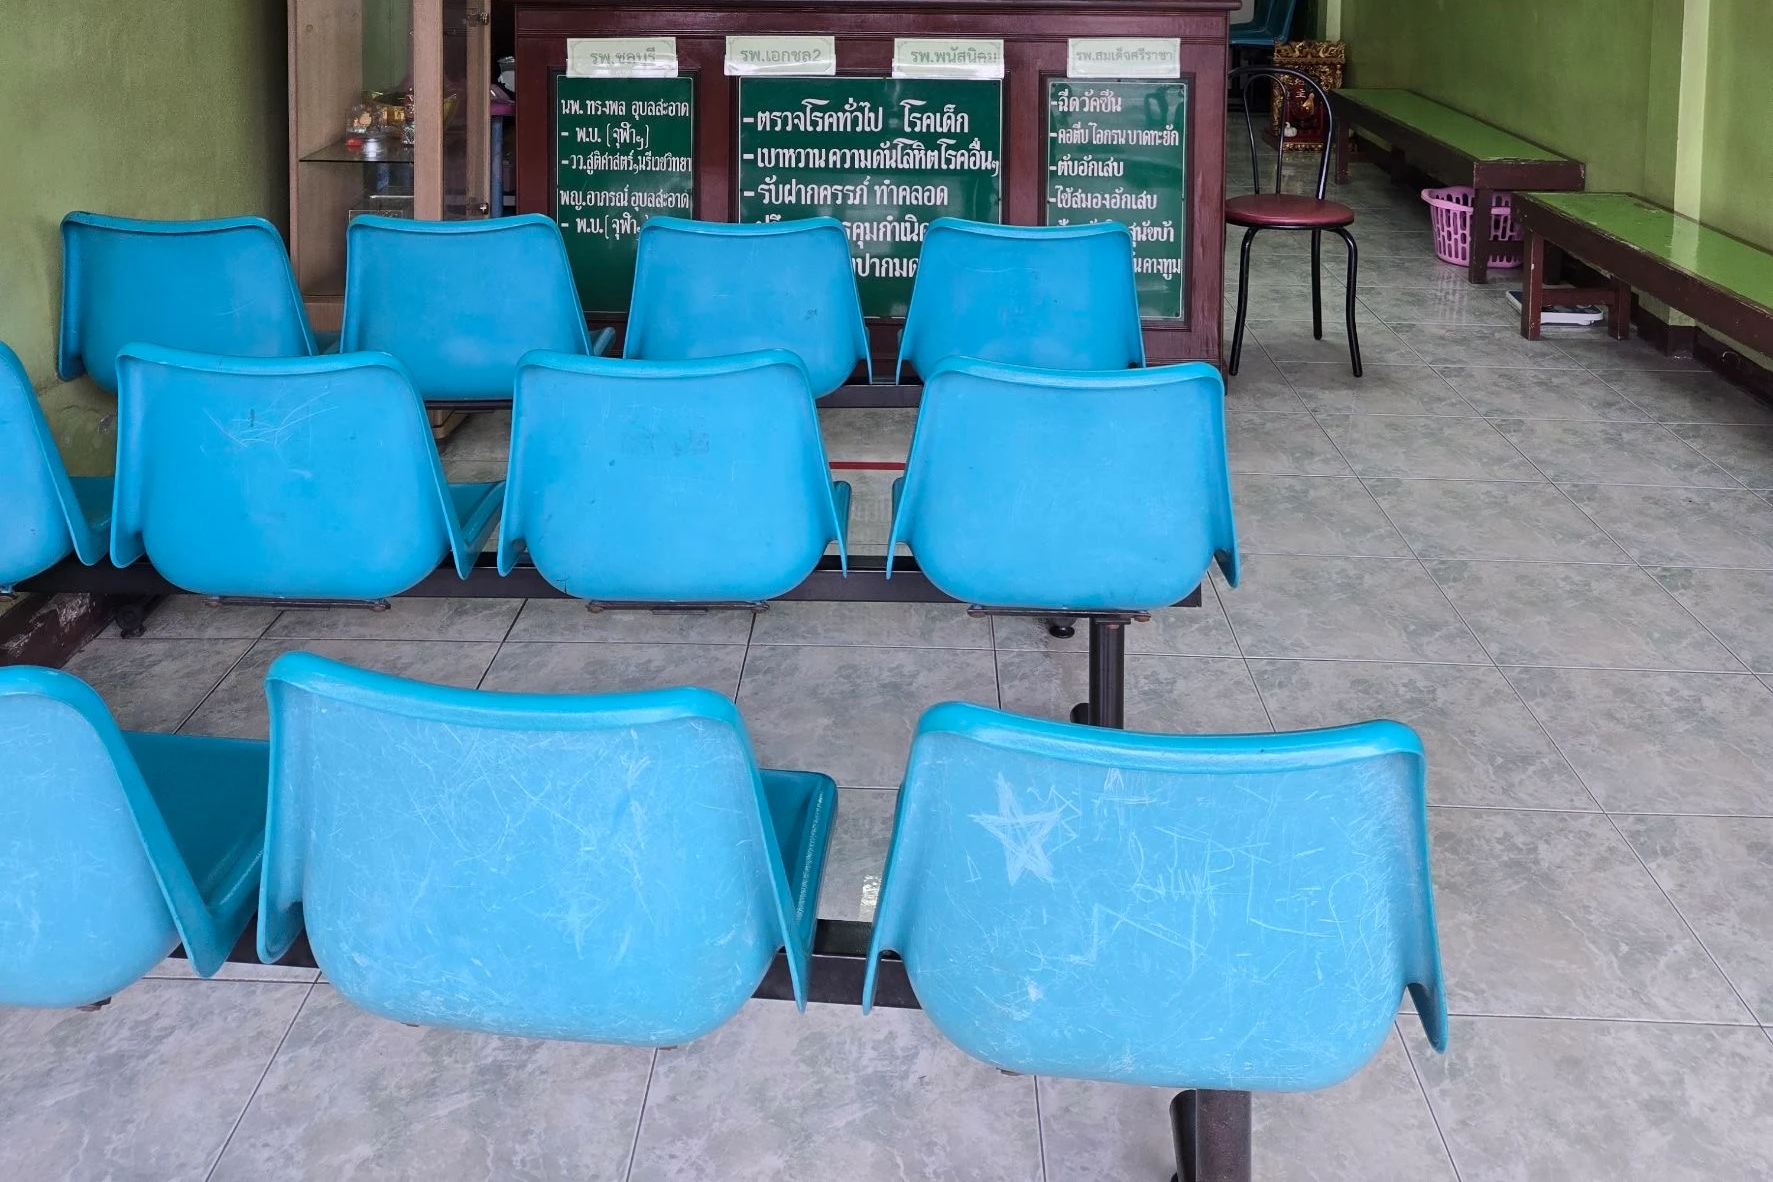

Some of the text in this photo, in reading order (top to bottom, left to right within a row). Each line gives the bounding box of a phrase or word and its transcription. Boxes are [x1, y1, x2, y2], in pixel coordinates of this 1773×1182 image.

[740, 48, 822, 64] รพ.เอกชล2
[910, 46, 997, 64] รพ.พนัสนิคม
[1075, 46, 1173, 62] รพ.สมเด็จศรีราชา
[560, 98, 689, 120] นพ. ทรงพล อุบลสะอาด
[900, 98, 969, 134] โรคเด็ก
[631, 189, 689, 212] อุบลสะอาด
[874, 178, 949, 206] ทำคลอด
[605, 211, 649, 240] (จุฬา
